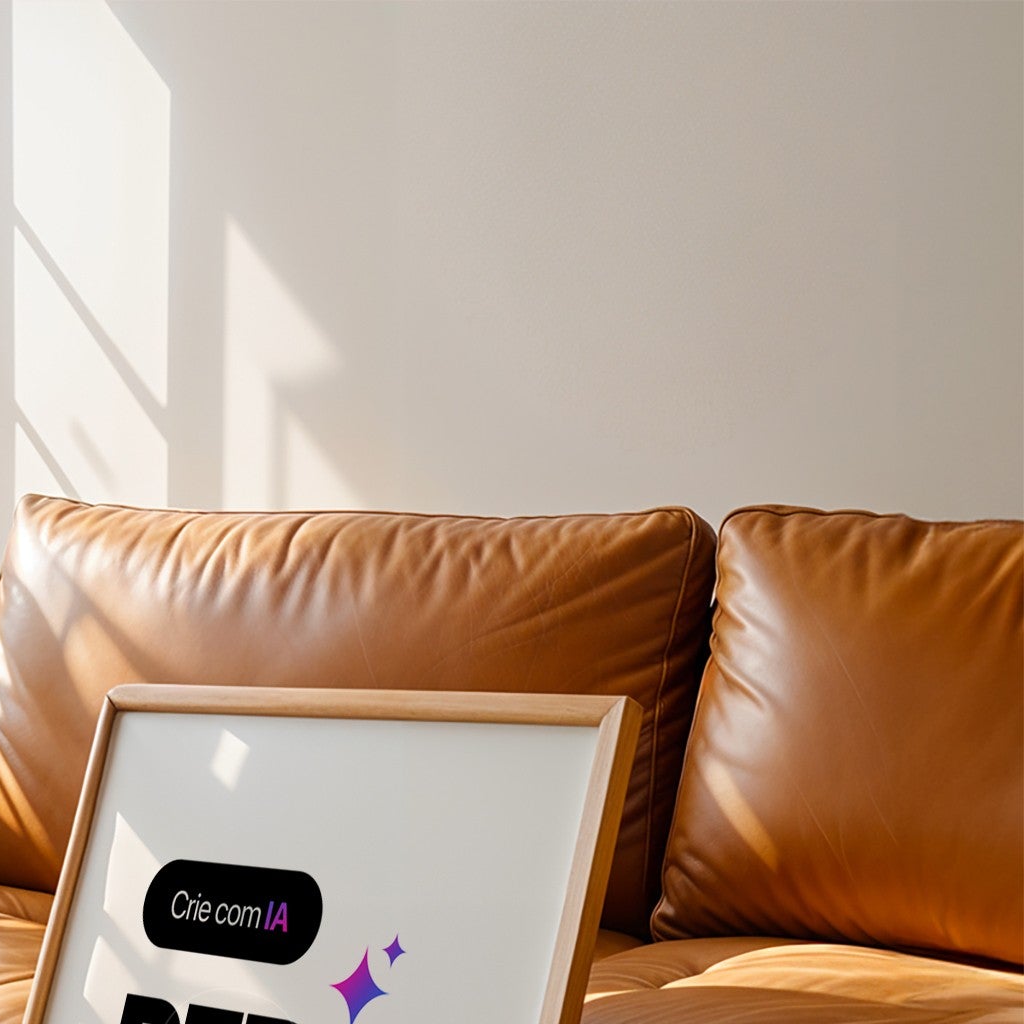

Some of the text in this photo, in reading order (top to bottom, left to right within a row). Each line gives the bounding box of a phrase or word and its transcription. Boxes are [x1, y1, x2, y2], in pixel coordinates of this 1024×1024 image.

[171, 889, 289, 933] Crie com IA
